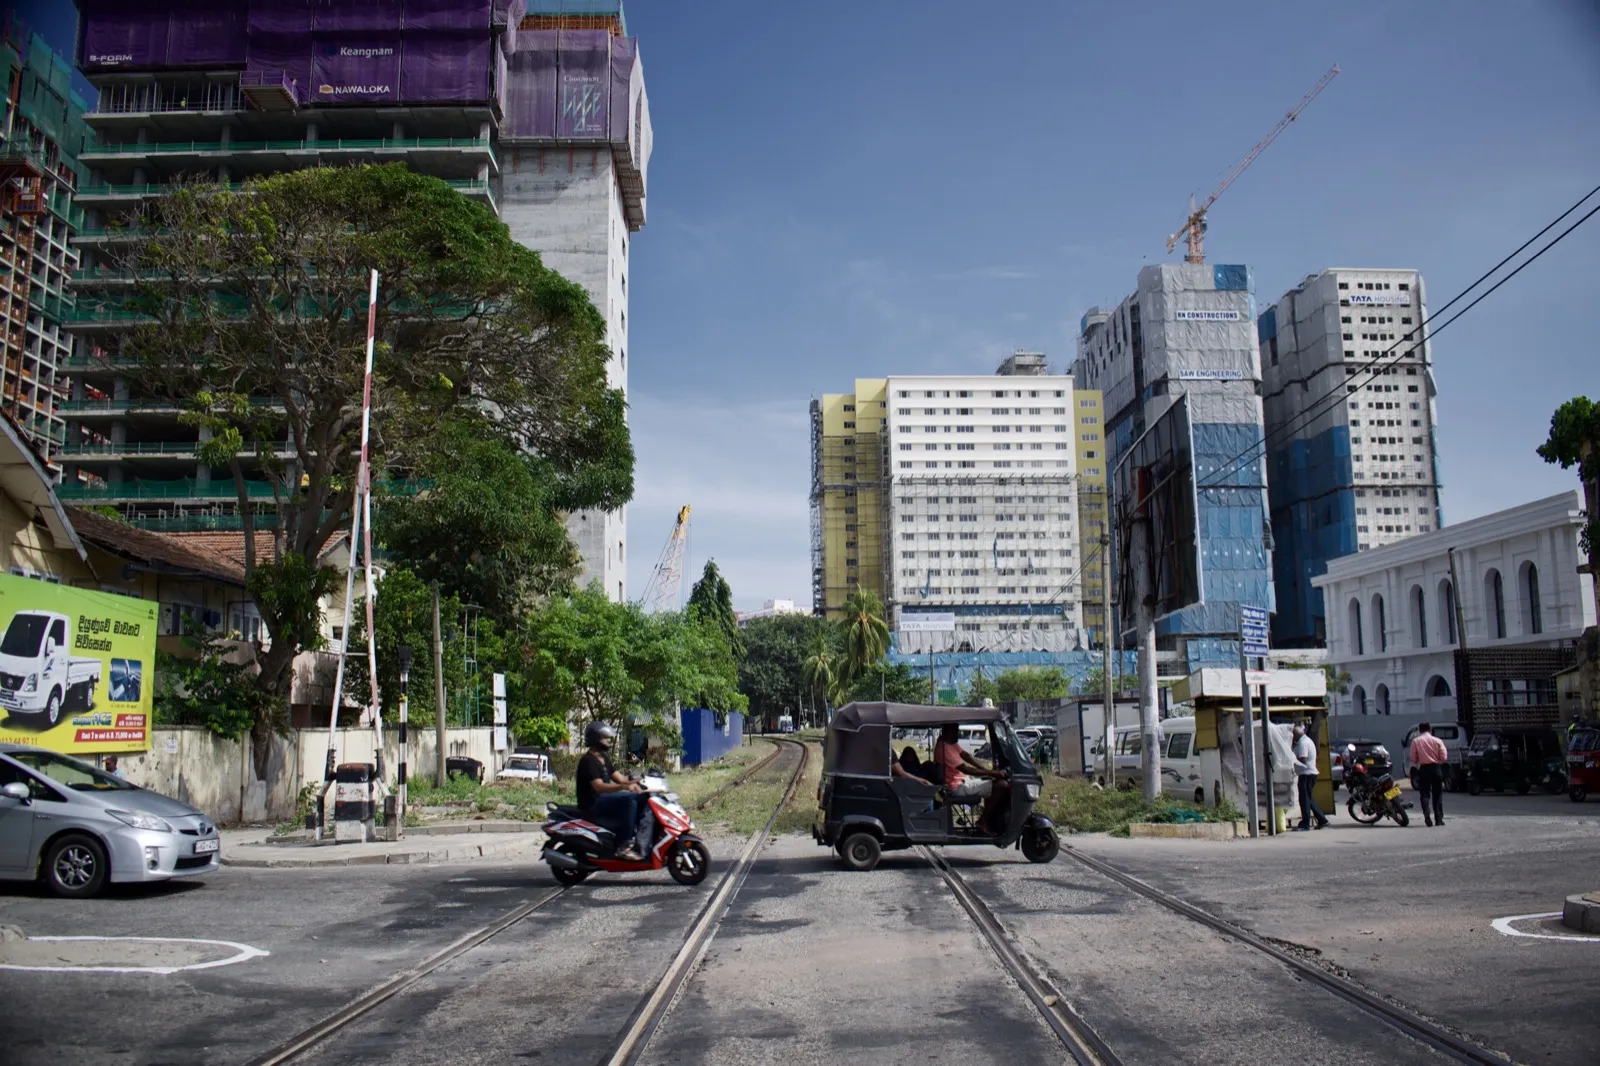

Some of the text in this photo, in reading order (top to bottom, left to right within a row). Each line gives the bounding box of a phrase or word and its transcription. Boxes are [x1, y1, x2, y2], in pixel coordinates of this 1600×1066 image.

[340, 47, 393, 58] Keangnam
[335, 86, 390, 94] NAWALOKA
[1196, 370, 1241, 378] ENGINEERING
